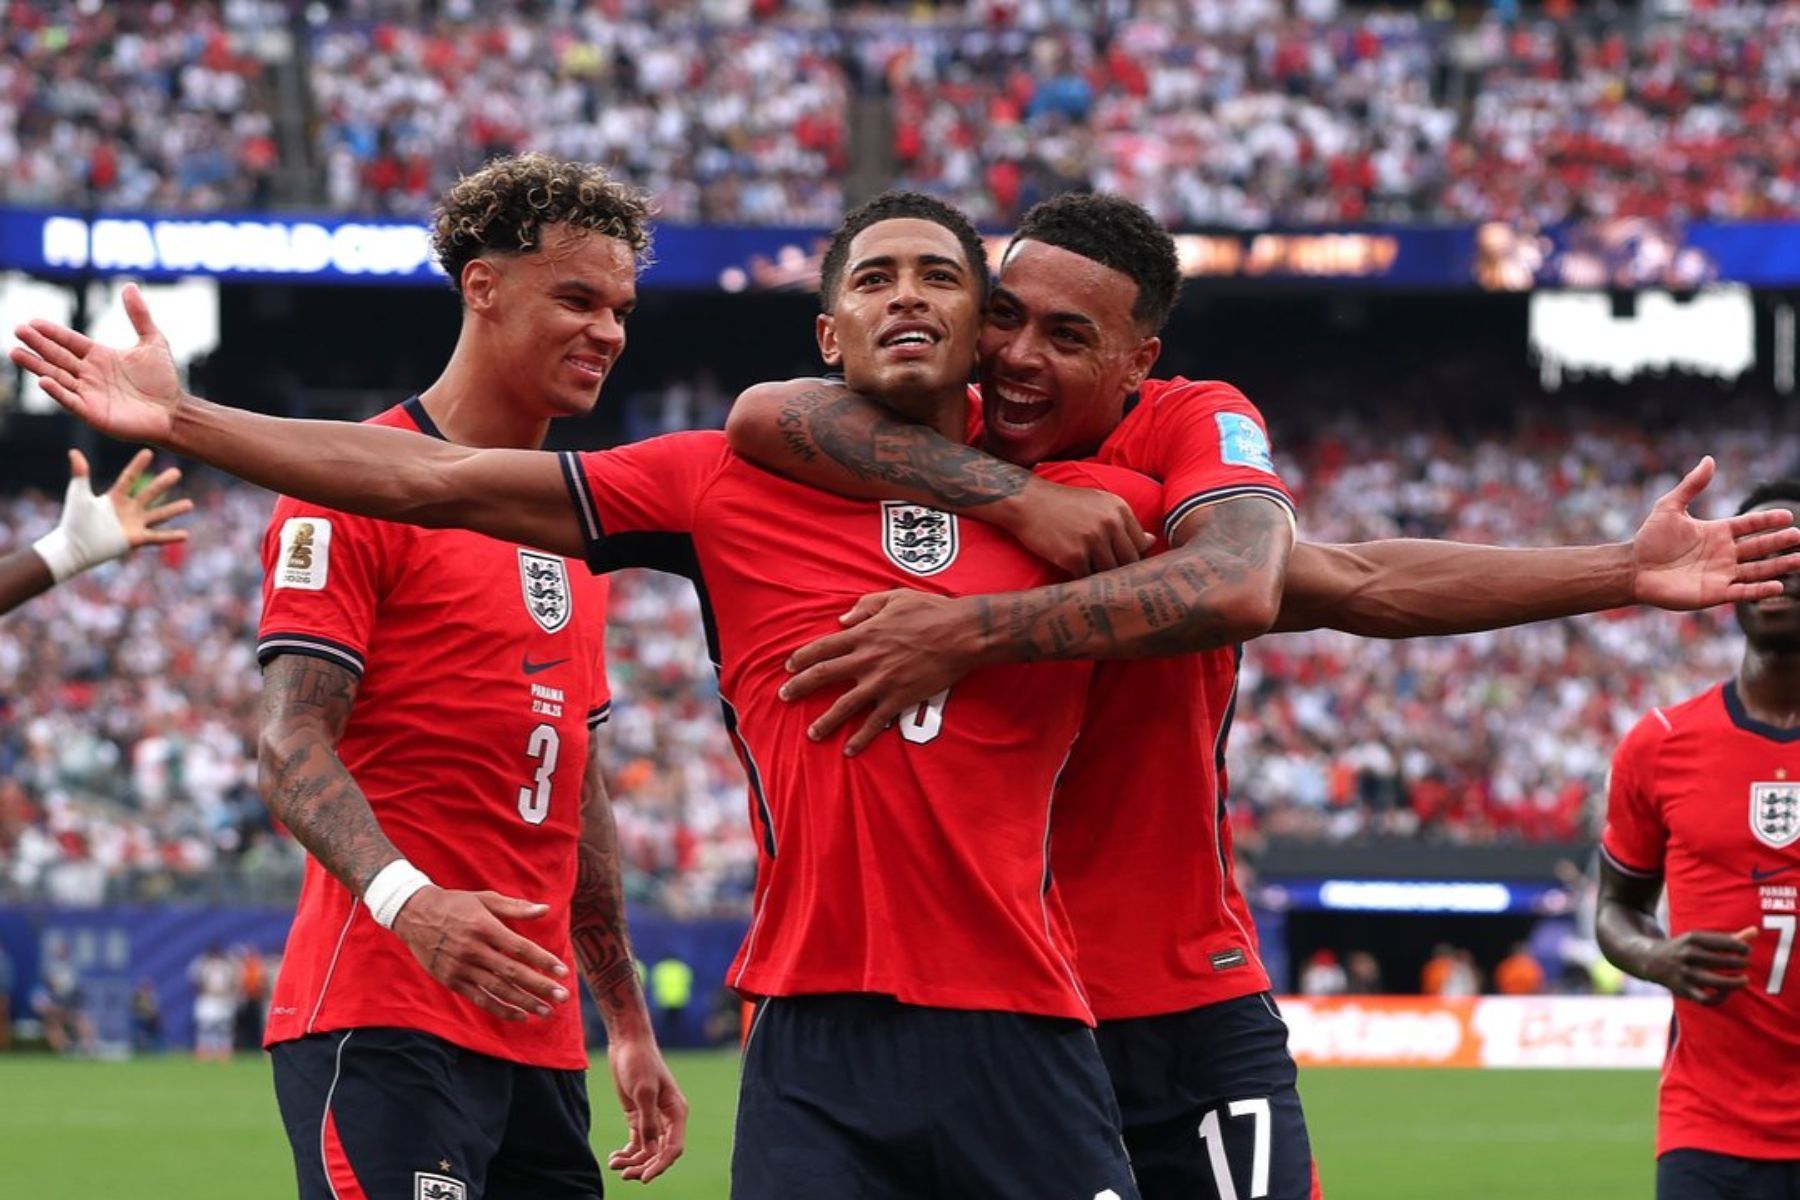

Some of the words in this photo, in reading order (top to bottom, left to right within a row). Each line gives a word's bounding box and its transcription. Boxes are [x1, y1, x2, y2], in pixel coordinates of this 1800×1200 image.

[531, 683, 565, 702] PANAMA
[518, 724, 560, 824] 3
[1763, 914, 1796, 994] 7
[1198, 1098, 1270, 1200] 17
